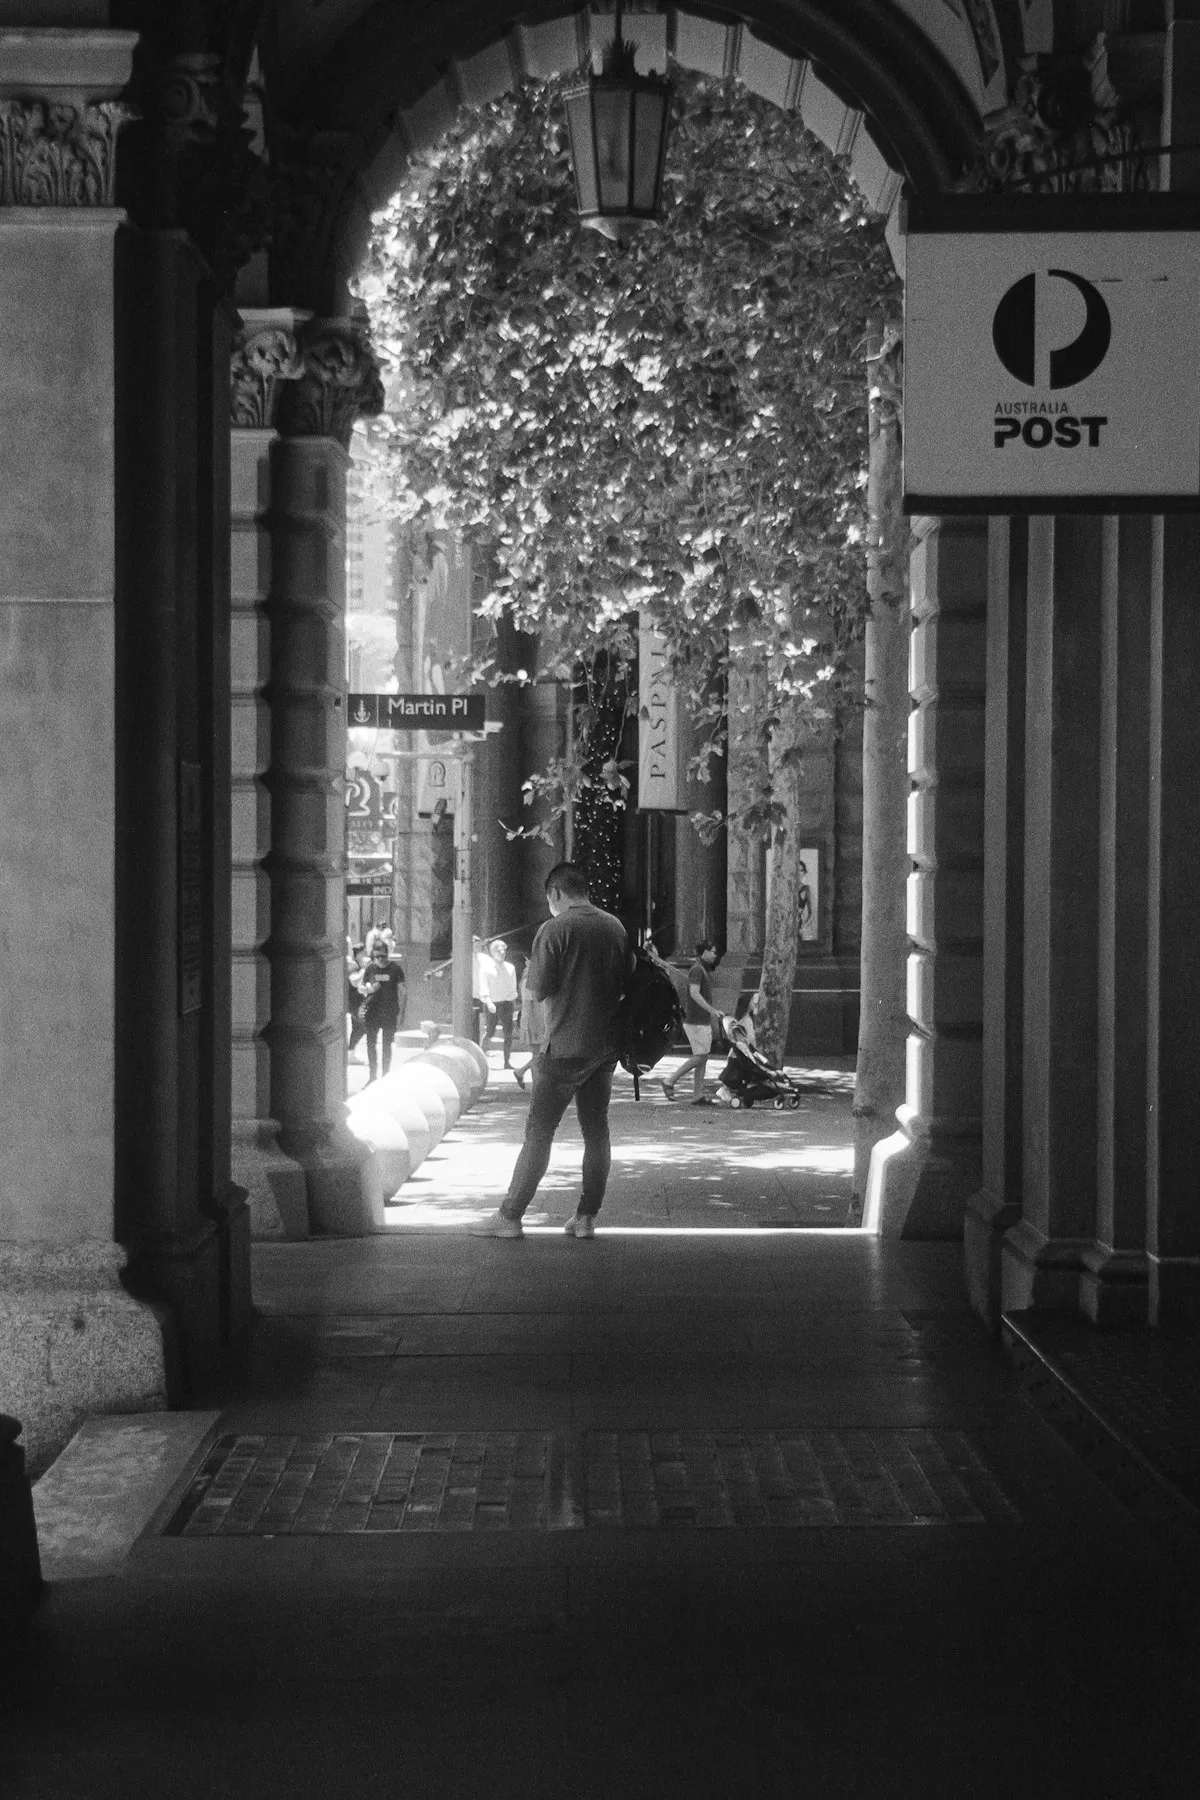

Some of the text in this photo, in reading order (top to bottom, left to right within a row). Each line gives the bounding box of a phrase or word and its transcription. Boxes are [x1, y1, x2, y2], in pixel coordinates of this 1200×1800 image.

[995, 402, 1068, 414] AUSTRALIA
[994, 417, 1108, 448] POST
[388, 698, 467, 715] Martin Pl
